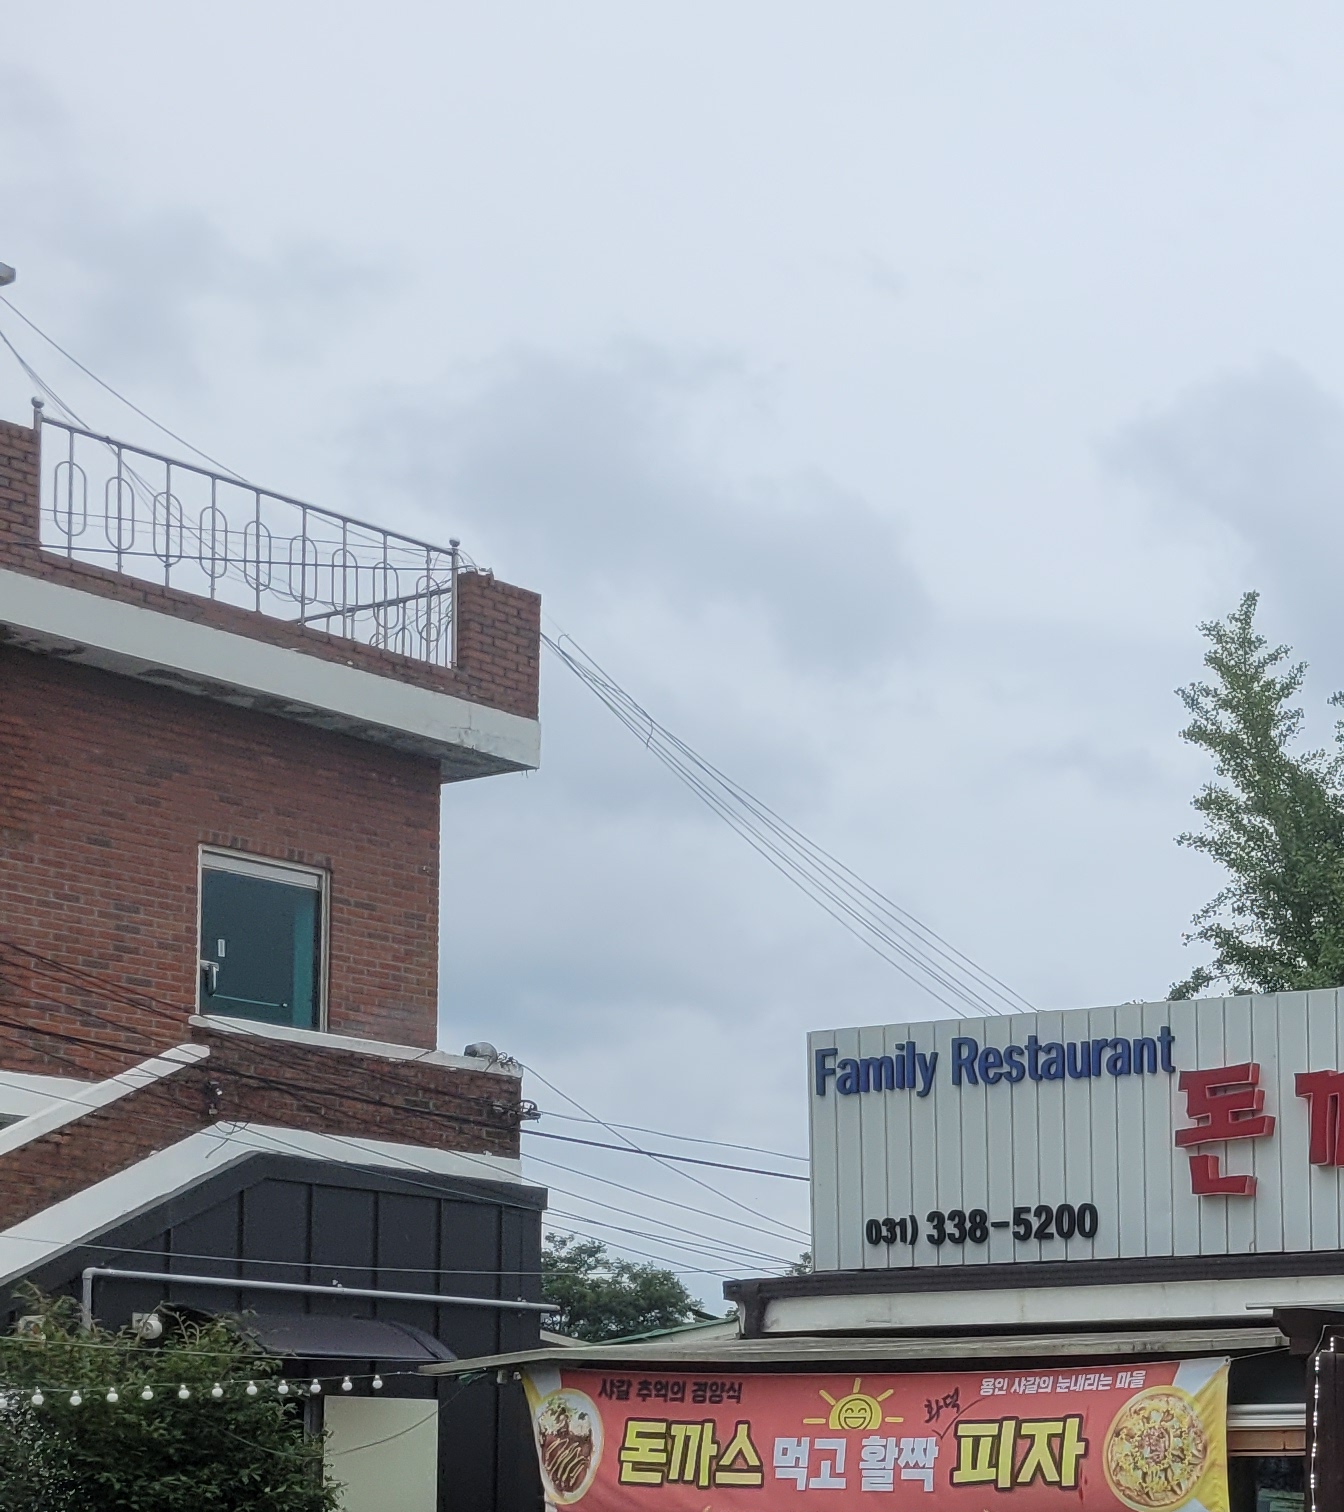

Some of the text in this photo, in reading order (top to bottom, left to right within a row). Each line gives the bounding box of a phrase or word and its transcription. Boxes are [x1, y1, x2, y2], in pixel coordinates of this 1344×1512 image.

[814, 1025, 1176, 1098] Family Restaurant
[865, 1202, 1099, 1247] 031) 338-5200
[636, 1379, 687, 1402] 추억의
[691, 1381, 743, 1404] 경양식
[979, 1370, 1147, 1396] 용인 샤갈의 눈내리는 마을
[923, 1386, 961, 1424] 화덕
[619, 1414, 1090, 1493] 돈까스 먹고 활짝 피자
